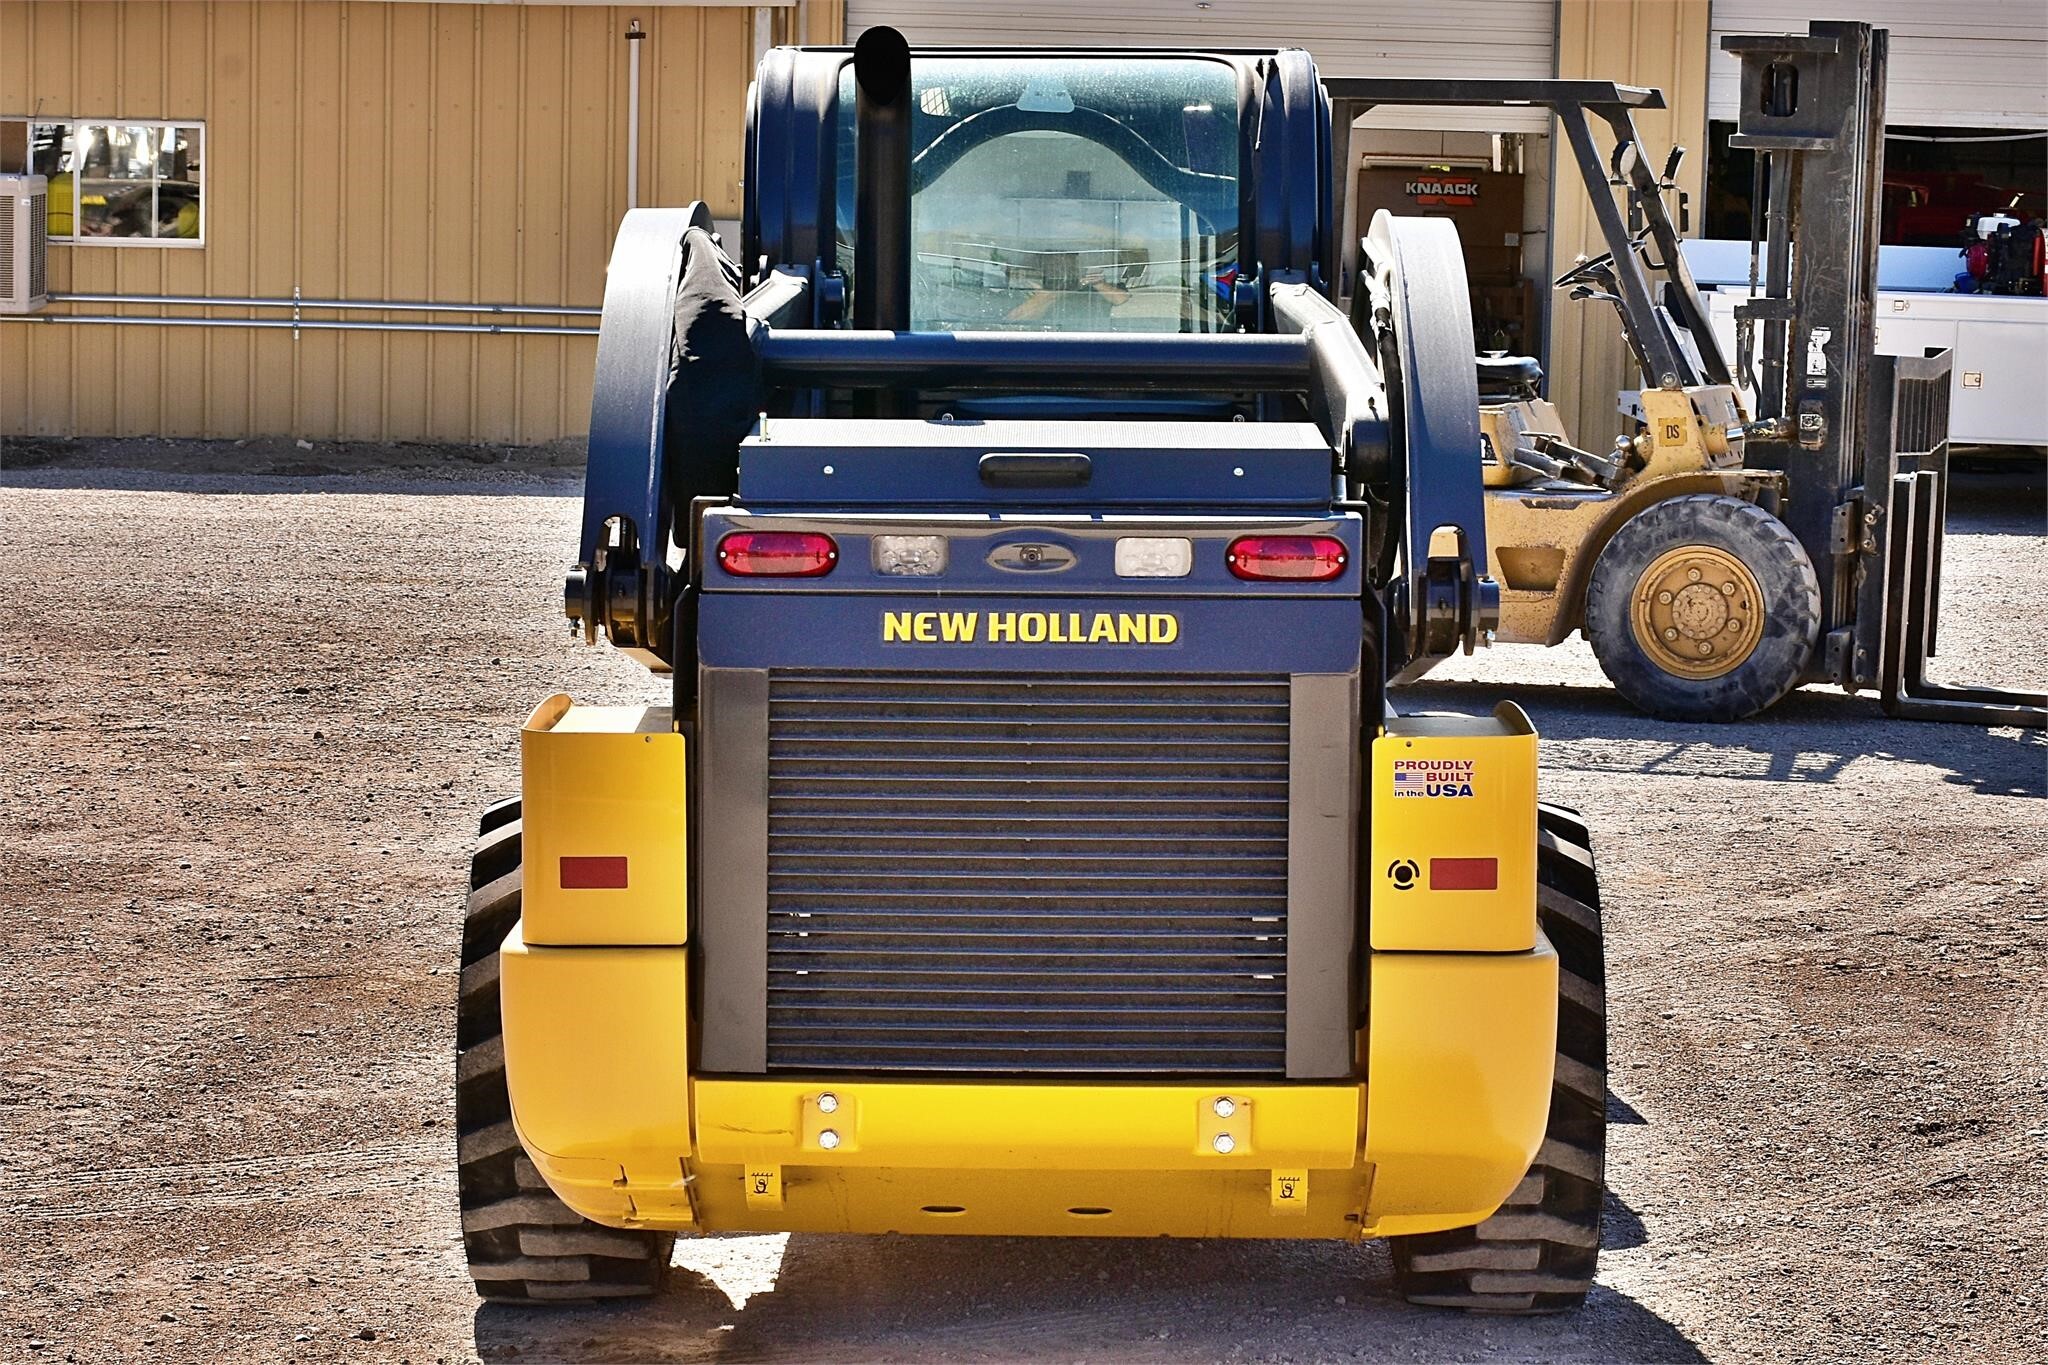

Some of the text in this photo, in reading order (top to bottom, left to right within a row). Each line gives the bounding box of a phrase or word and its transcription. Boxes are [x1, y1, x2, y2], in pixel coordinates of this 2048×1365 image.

[1405, 182, 1478, 195] KNAACK
[883, 612, 1178, 643] NEW HOLLAND
[1394, 761, 1473, 770] PROUDLY
[1426, 772, 1473, 782] BUILT
[1426, 784, 1473, 797] USA
